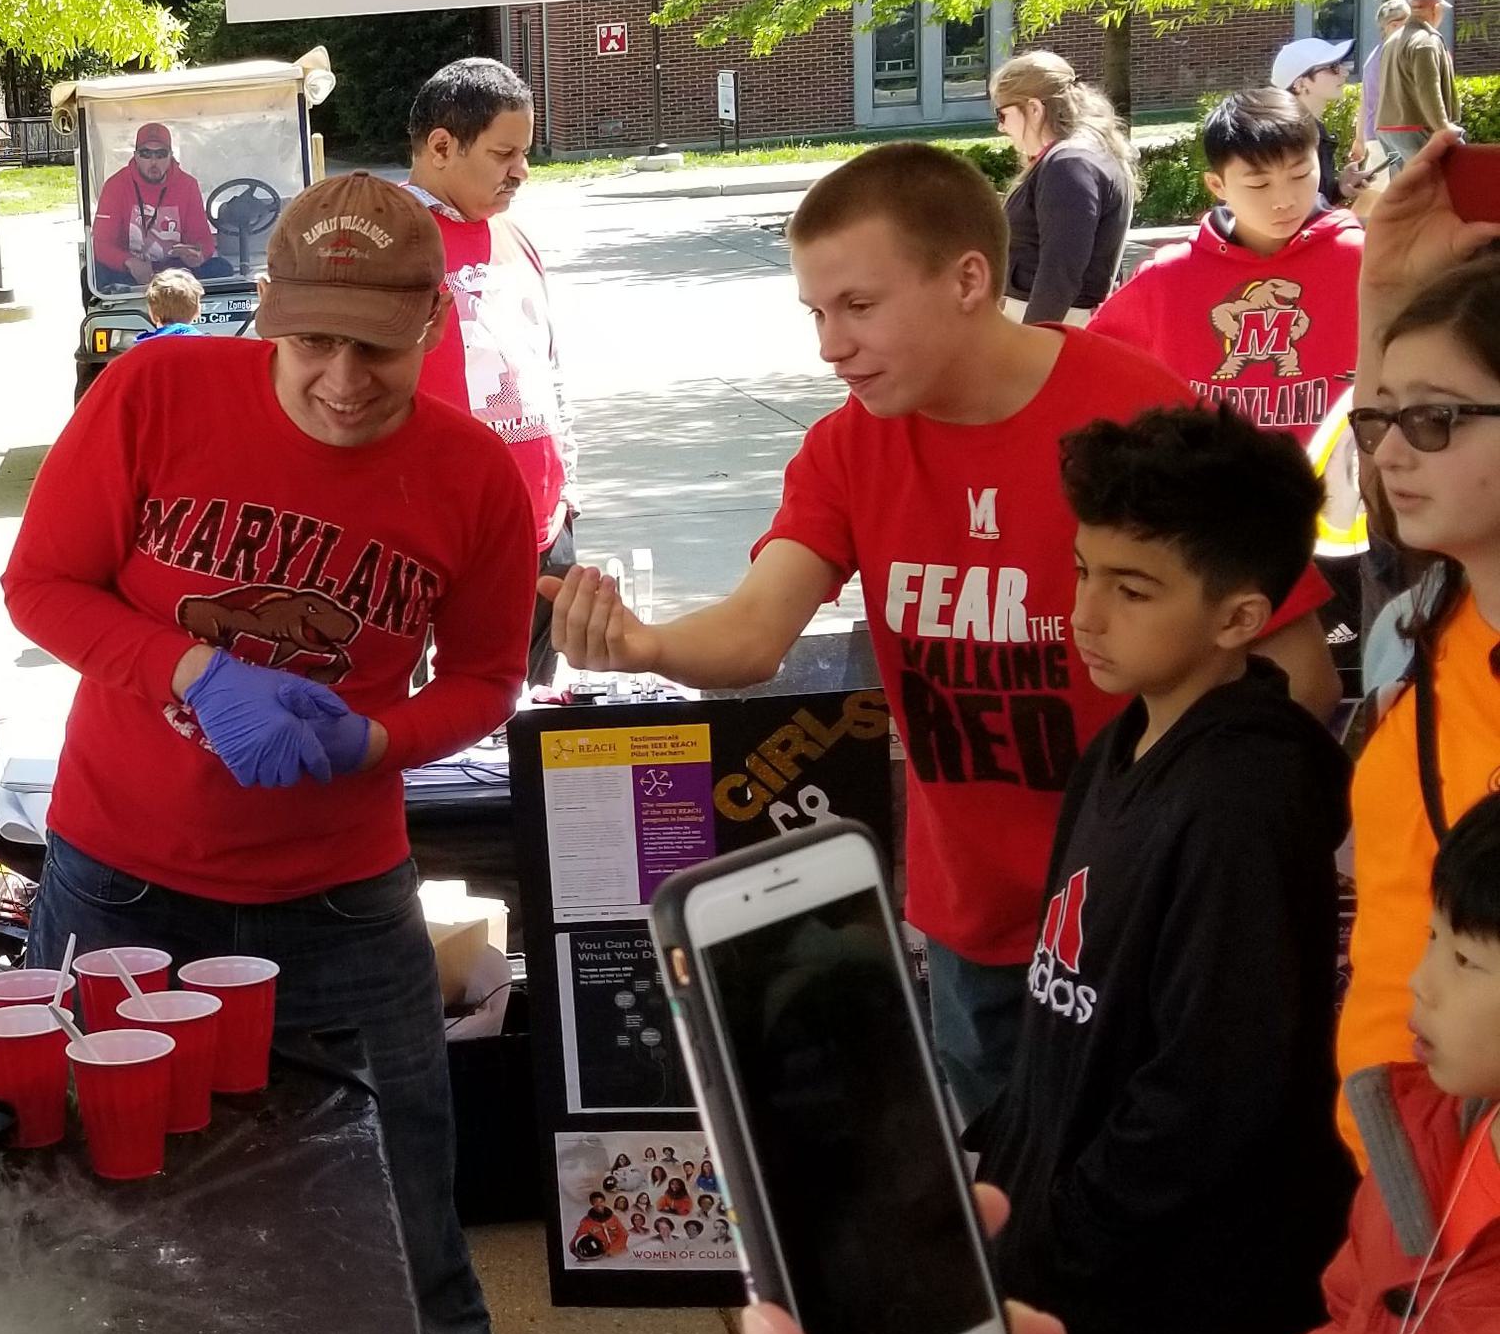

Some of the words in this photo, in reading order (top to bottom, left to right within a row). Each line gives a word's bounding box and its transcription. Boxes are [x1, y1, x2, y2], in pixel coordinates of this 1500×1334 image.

[209, 313, 232, 323] Car
[136, 496, 444, 638] MARYLAND
[885, 561, 1030, 644] FEAR
[1028, 616, 1066, 643] THE
[901, 669, 1081, 793] RED
[578, 742, 617, 753] REACH
[670, 740, 697, 748] REACH
[713, 689, 891, 822] GIRLS
[577, 940, 601, 950] You
[604, 939, 631, 949] Can
[577, 951, 612, 961] What
[614, 950, 639, 960] You
[632, 1250, 677, 1259] WOMEN
[678, 1250, 696, 1259] OF
